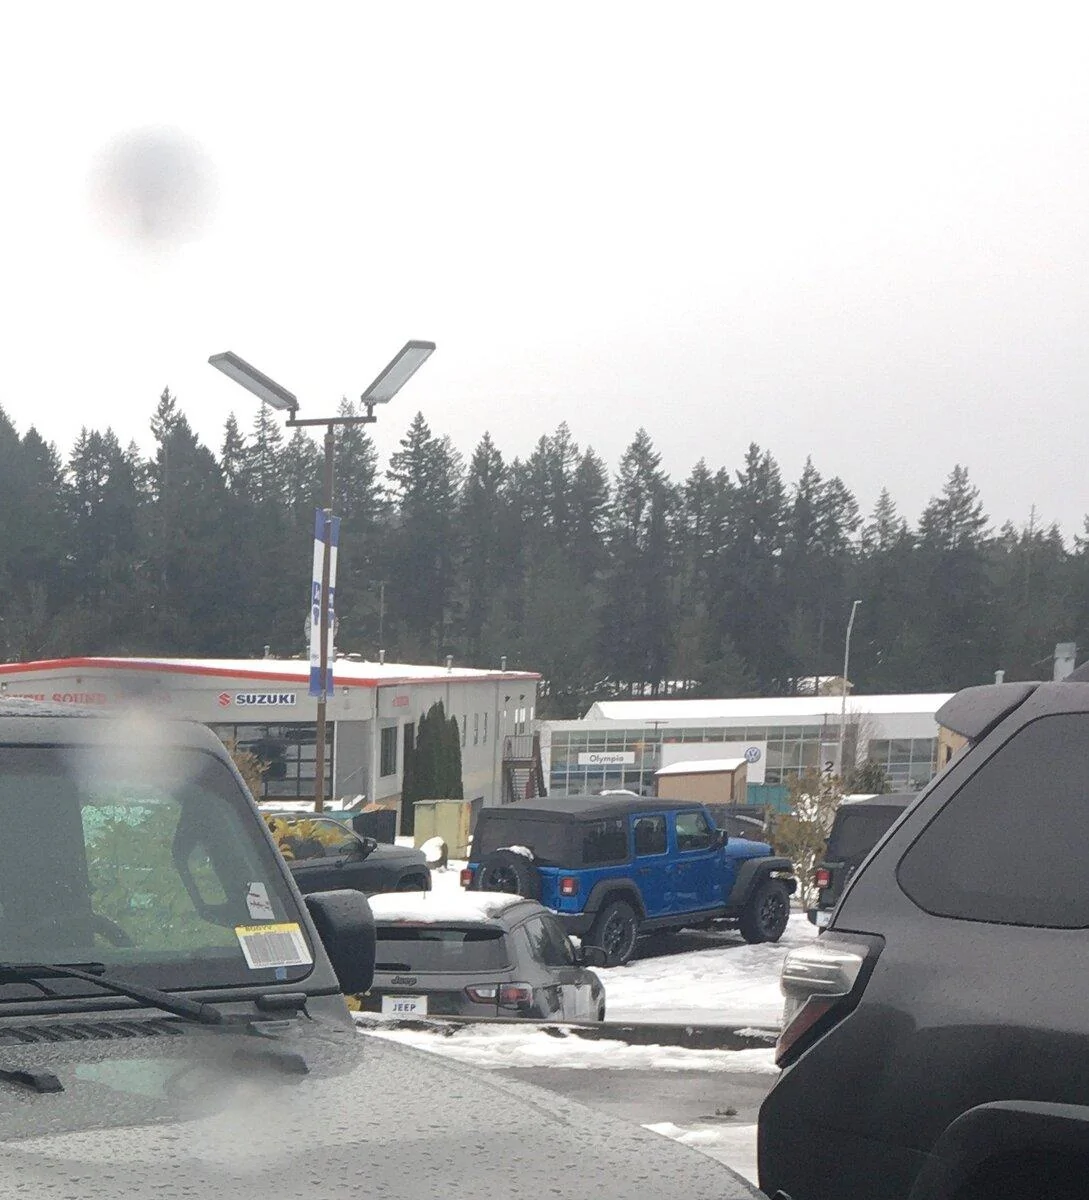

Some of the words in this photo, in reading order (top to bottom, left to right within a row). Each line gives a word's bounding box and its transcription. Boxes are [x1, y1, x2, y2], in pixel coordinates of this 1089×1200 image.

[236, 693, 295, 705] SUZUKI
[589, 754, 624, 763] Olympia
[392, 1003, 417, 1012] JEEP
